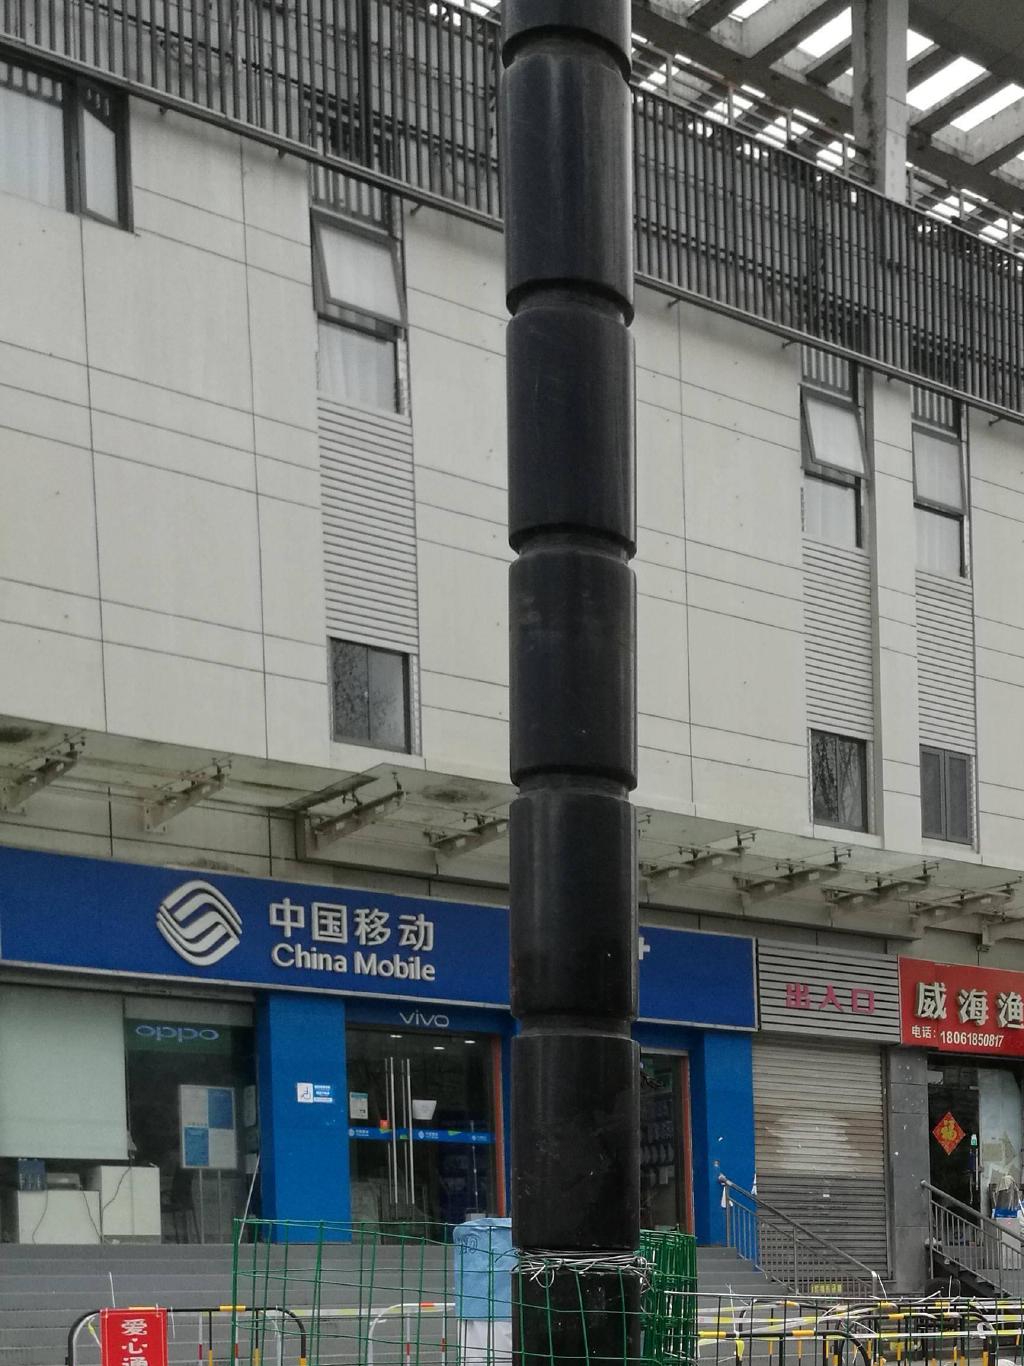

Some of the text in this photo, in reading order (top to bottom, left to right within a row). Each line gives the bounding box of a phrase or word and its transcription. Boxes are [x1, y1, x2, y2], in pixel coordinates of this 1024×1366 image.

[269, 897, 435, 952] 中国移动
[271, 943, 436, 981] China Mobile
[784, 982, 876, 1016] 出入口
[400, 1009, 450, 1028] vivo
[940, 1031, 1004, 1048] 18061850817
